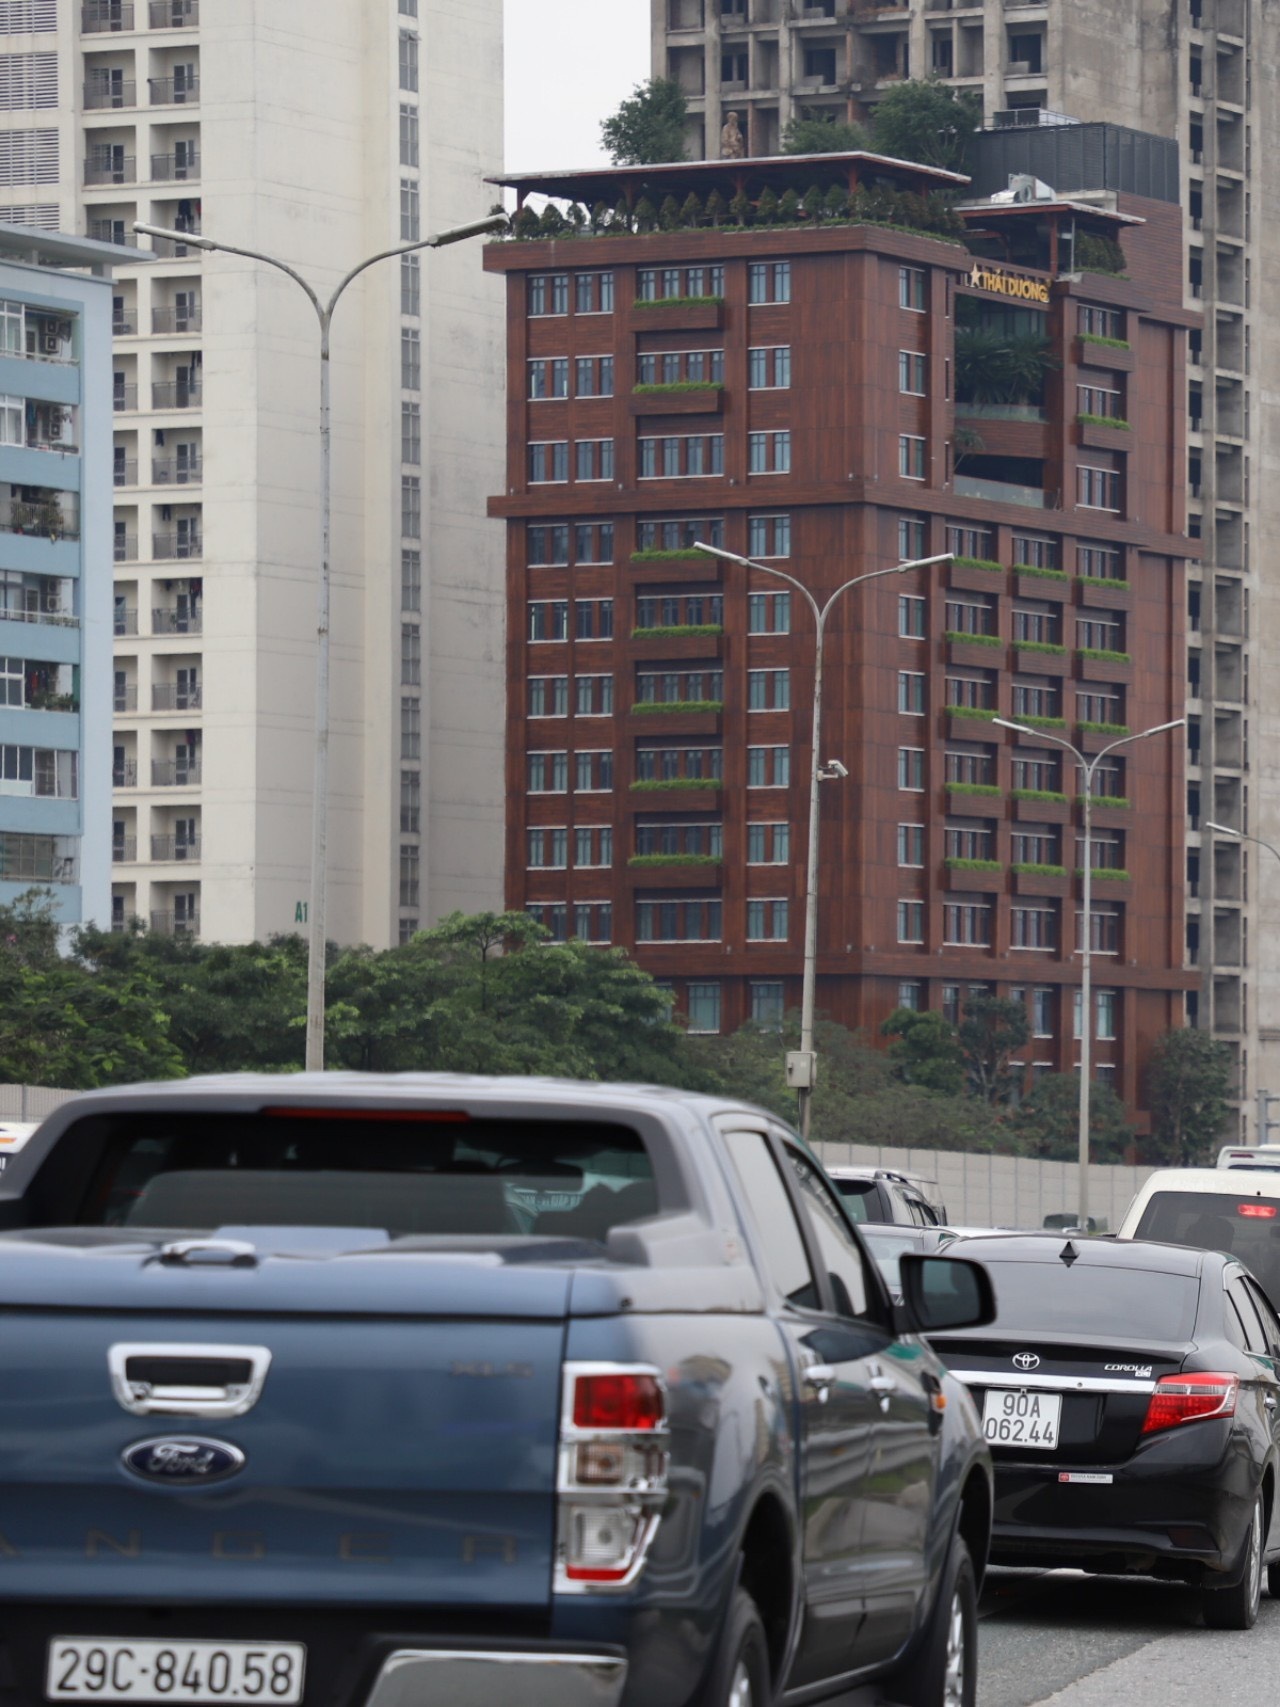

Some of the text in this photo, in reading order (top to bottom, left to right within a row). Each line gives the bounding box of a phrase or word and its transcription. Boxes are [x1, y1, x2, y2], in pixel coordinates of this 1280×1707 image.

[983, 268, 1006, 294] THÁI
[294, 901, 308, 923] A1
[1104, 1364, 1153, 1372] COROLLA
[1002, 1393, 1041, 1419] 90A
[985, 1418, 1055, 1445] 062.44
[148, 1443, 215, 1475] Ford
[57, 1648, 295, 1697] 29C-840.58
